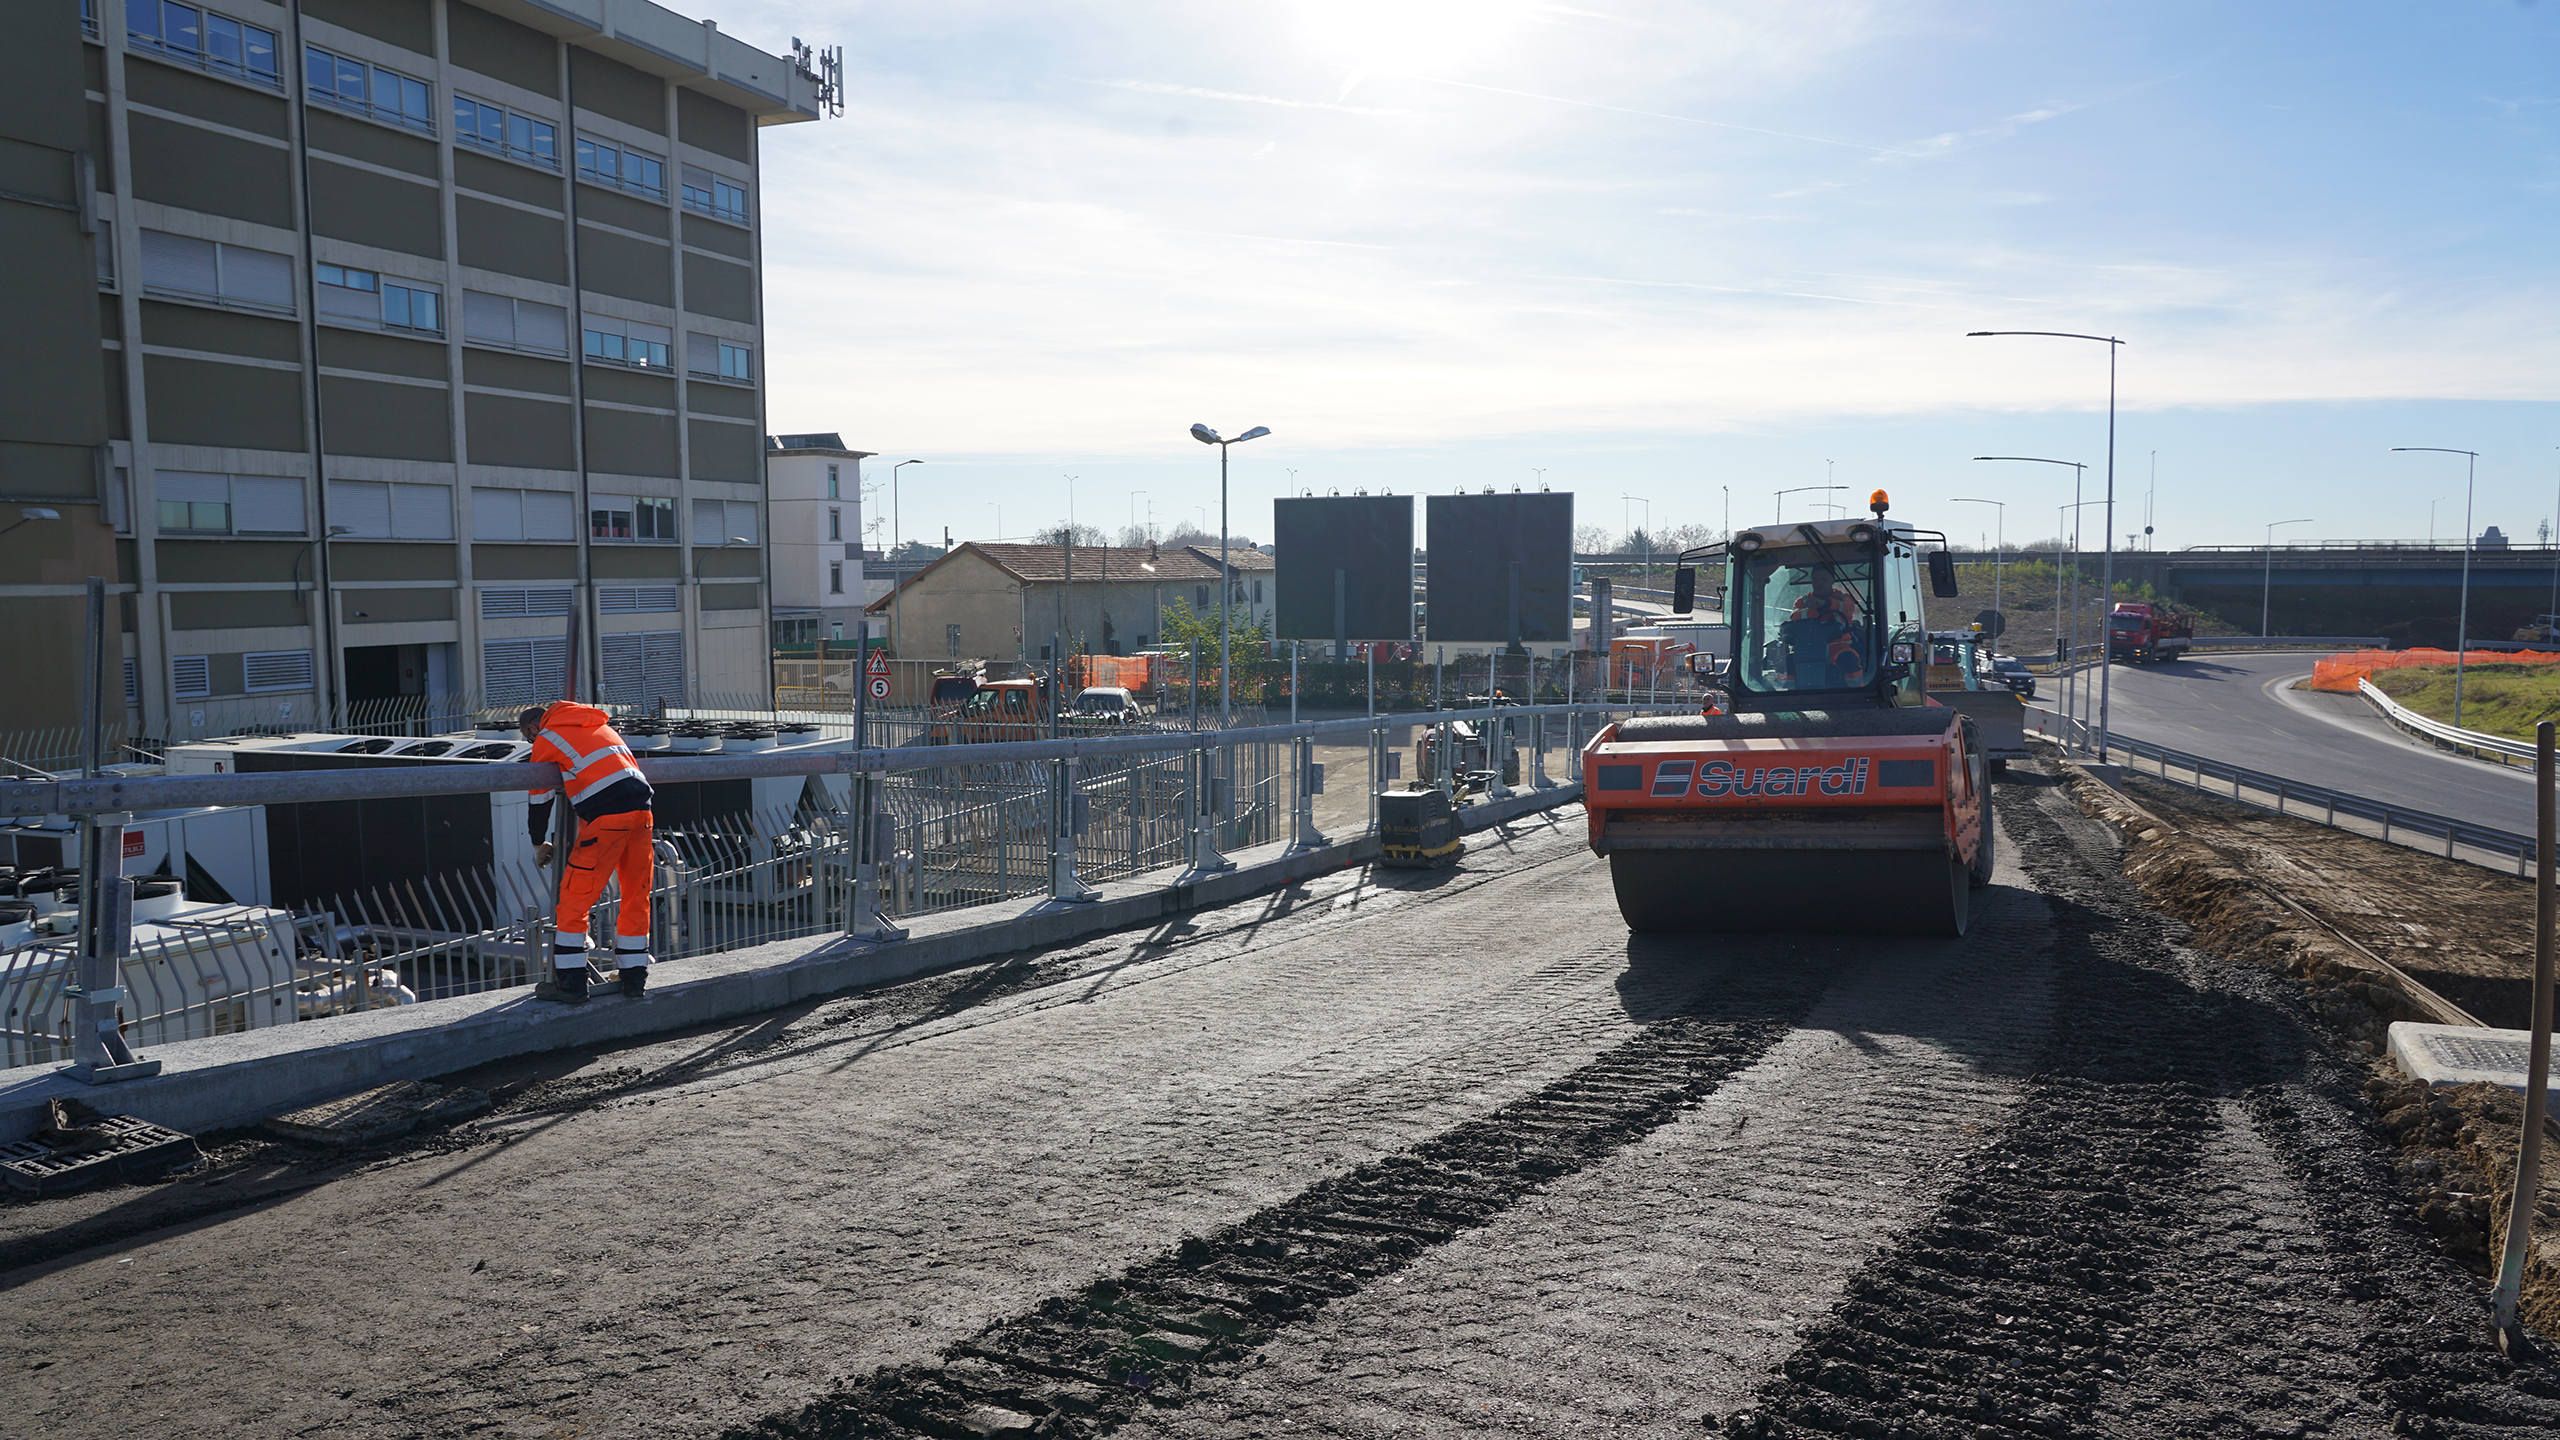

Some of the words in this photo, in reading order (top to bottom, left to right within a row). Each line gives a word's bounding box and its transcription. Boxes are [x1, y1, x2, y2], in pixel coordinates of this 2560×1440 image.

[876, 683, 884, 694] 5
[1697, 757, 1870, 796] Suardi
[123, 845, 144, 853] TULZ
